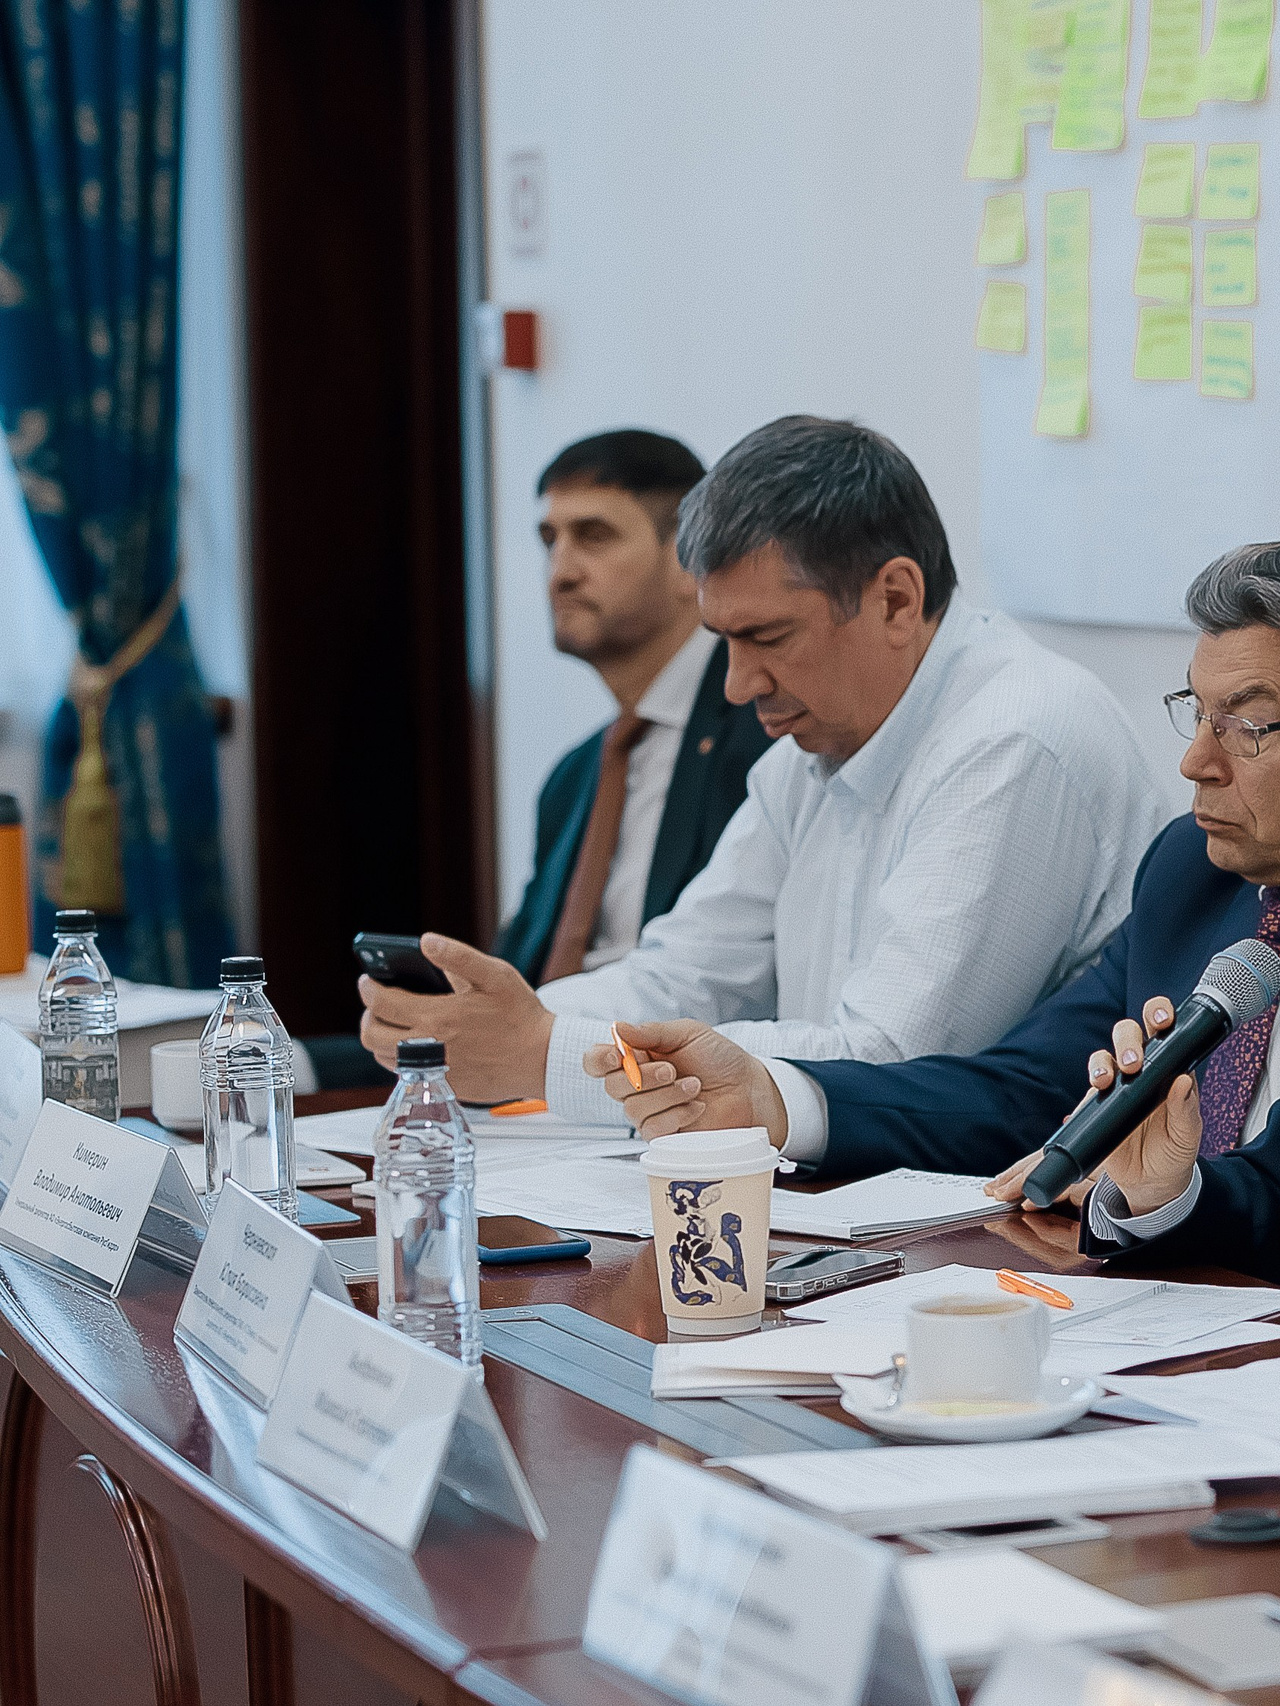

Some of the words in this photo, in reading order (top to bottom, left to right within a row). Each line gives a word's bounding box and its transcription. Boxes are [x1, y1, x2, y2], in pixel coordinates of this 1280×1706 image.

[73, 1142, 109, 1170] Кимерин
[33, 1169, 71, 1202] Владимир
[68, 1184, 123, 1222] Анатольевич
